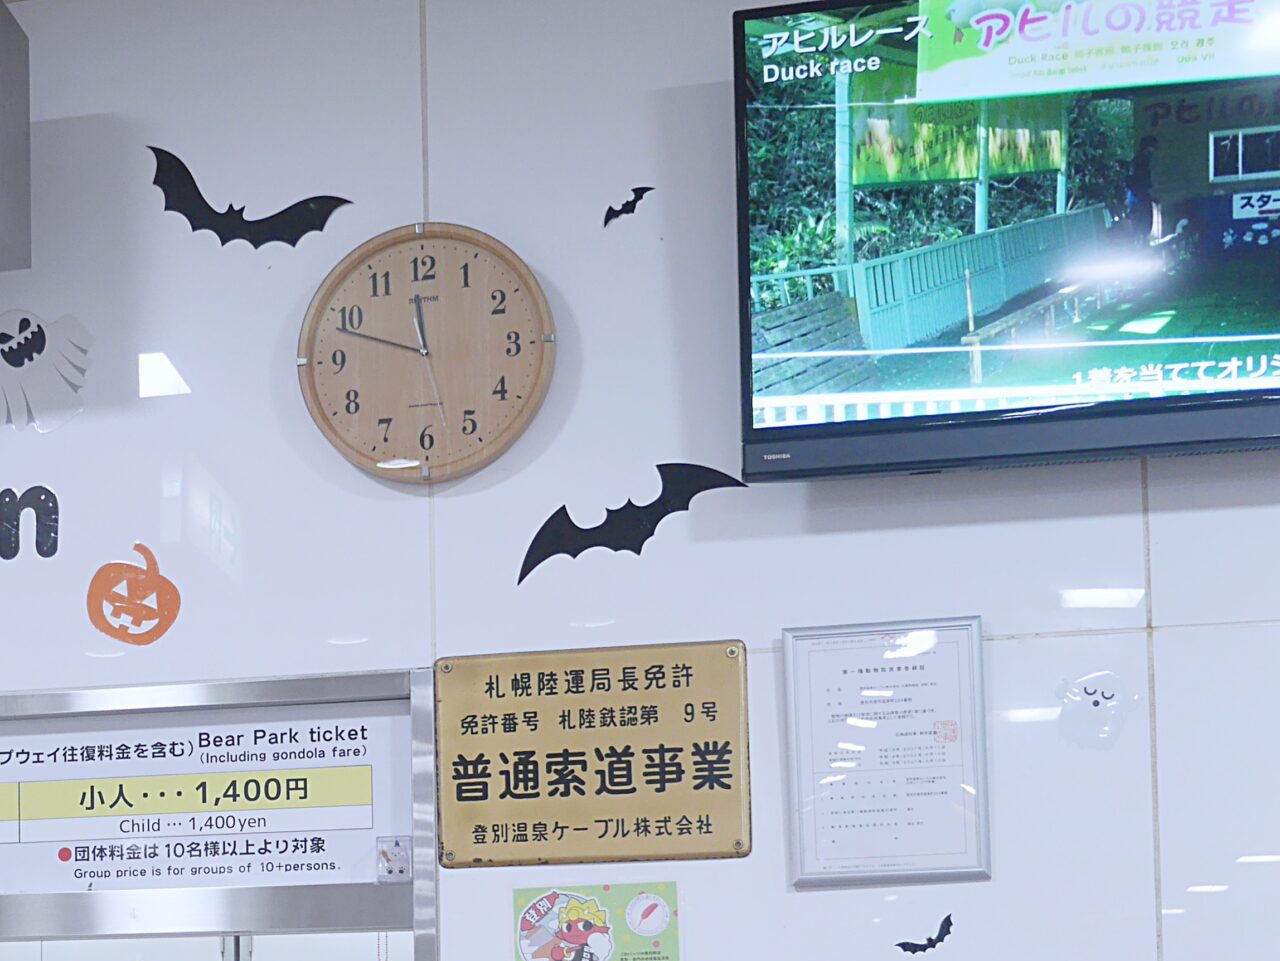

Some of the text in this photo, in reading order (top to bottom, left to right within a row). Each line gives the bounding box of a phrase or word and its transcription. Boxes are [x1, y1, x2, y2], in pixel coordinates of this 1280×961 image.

[762, 16, 934, 59] アヒルレース
[763, 56, 881, 83] Duck race
[1008, 55, 1037, 65] Duck
[410, 255, 436, 282] 12
[460, 262, 471, 288] 1
[369, 271, 392, 297] 11
[491, 289, 506, 315] 2
[338, 305, 363, 331] 10
[506, 331, 521, 357] 3
[331, 349, 346, 375] 9
[492, 376, 508, 401] 4
[345, 389, 360, 415] 8
[377, 417, 392, 443] 7
[462, 409, 477, 435] 5
[420, 425, 434, 451] 6
[484, 664, 694, 699] 札幌陸運局長免許
[461, 701, 718, 735] 免許番号 札陸鉄認第 9号
[198, 725, 368, 749] Bear Park ticket
[199, 744, 368, 765] (Including gondola fare)
[452, 740, 734, 802] 普通索道事業
[119, 818, 161, 833] Child
[472, 814, 714, 844] 登別温泉ケーブル株式会社
[74, 837, 326, 862] 団体料金は10名様以上より対象
[74, 866, 111, 879] Group
[116, 866, 147, 878] price
[151, 864, 161, 876] is
[167, 863, 186, 876] for
[190, 864, 233, 876] groups
[238, 861, 252, 873] of
